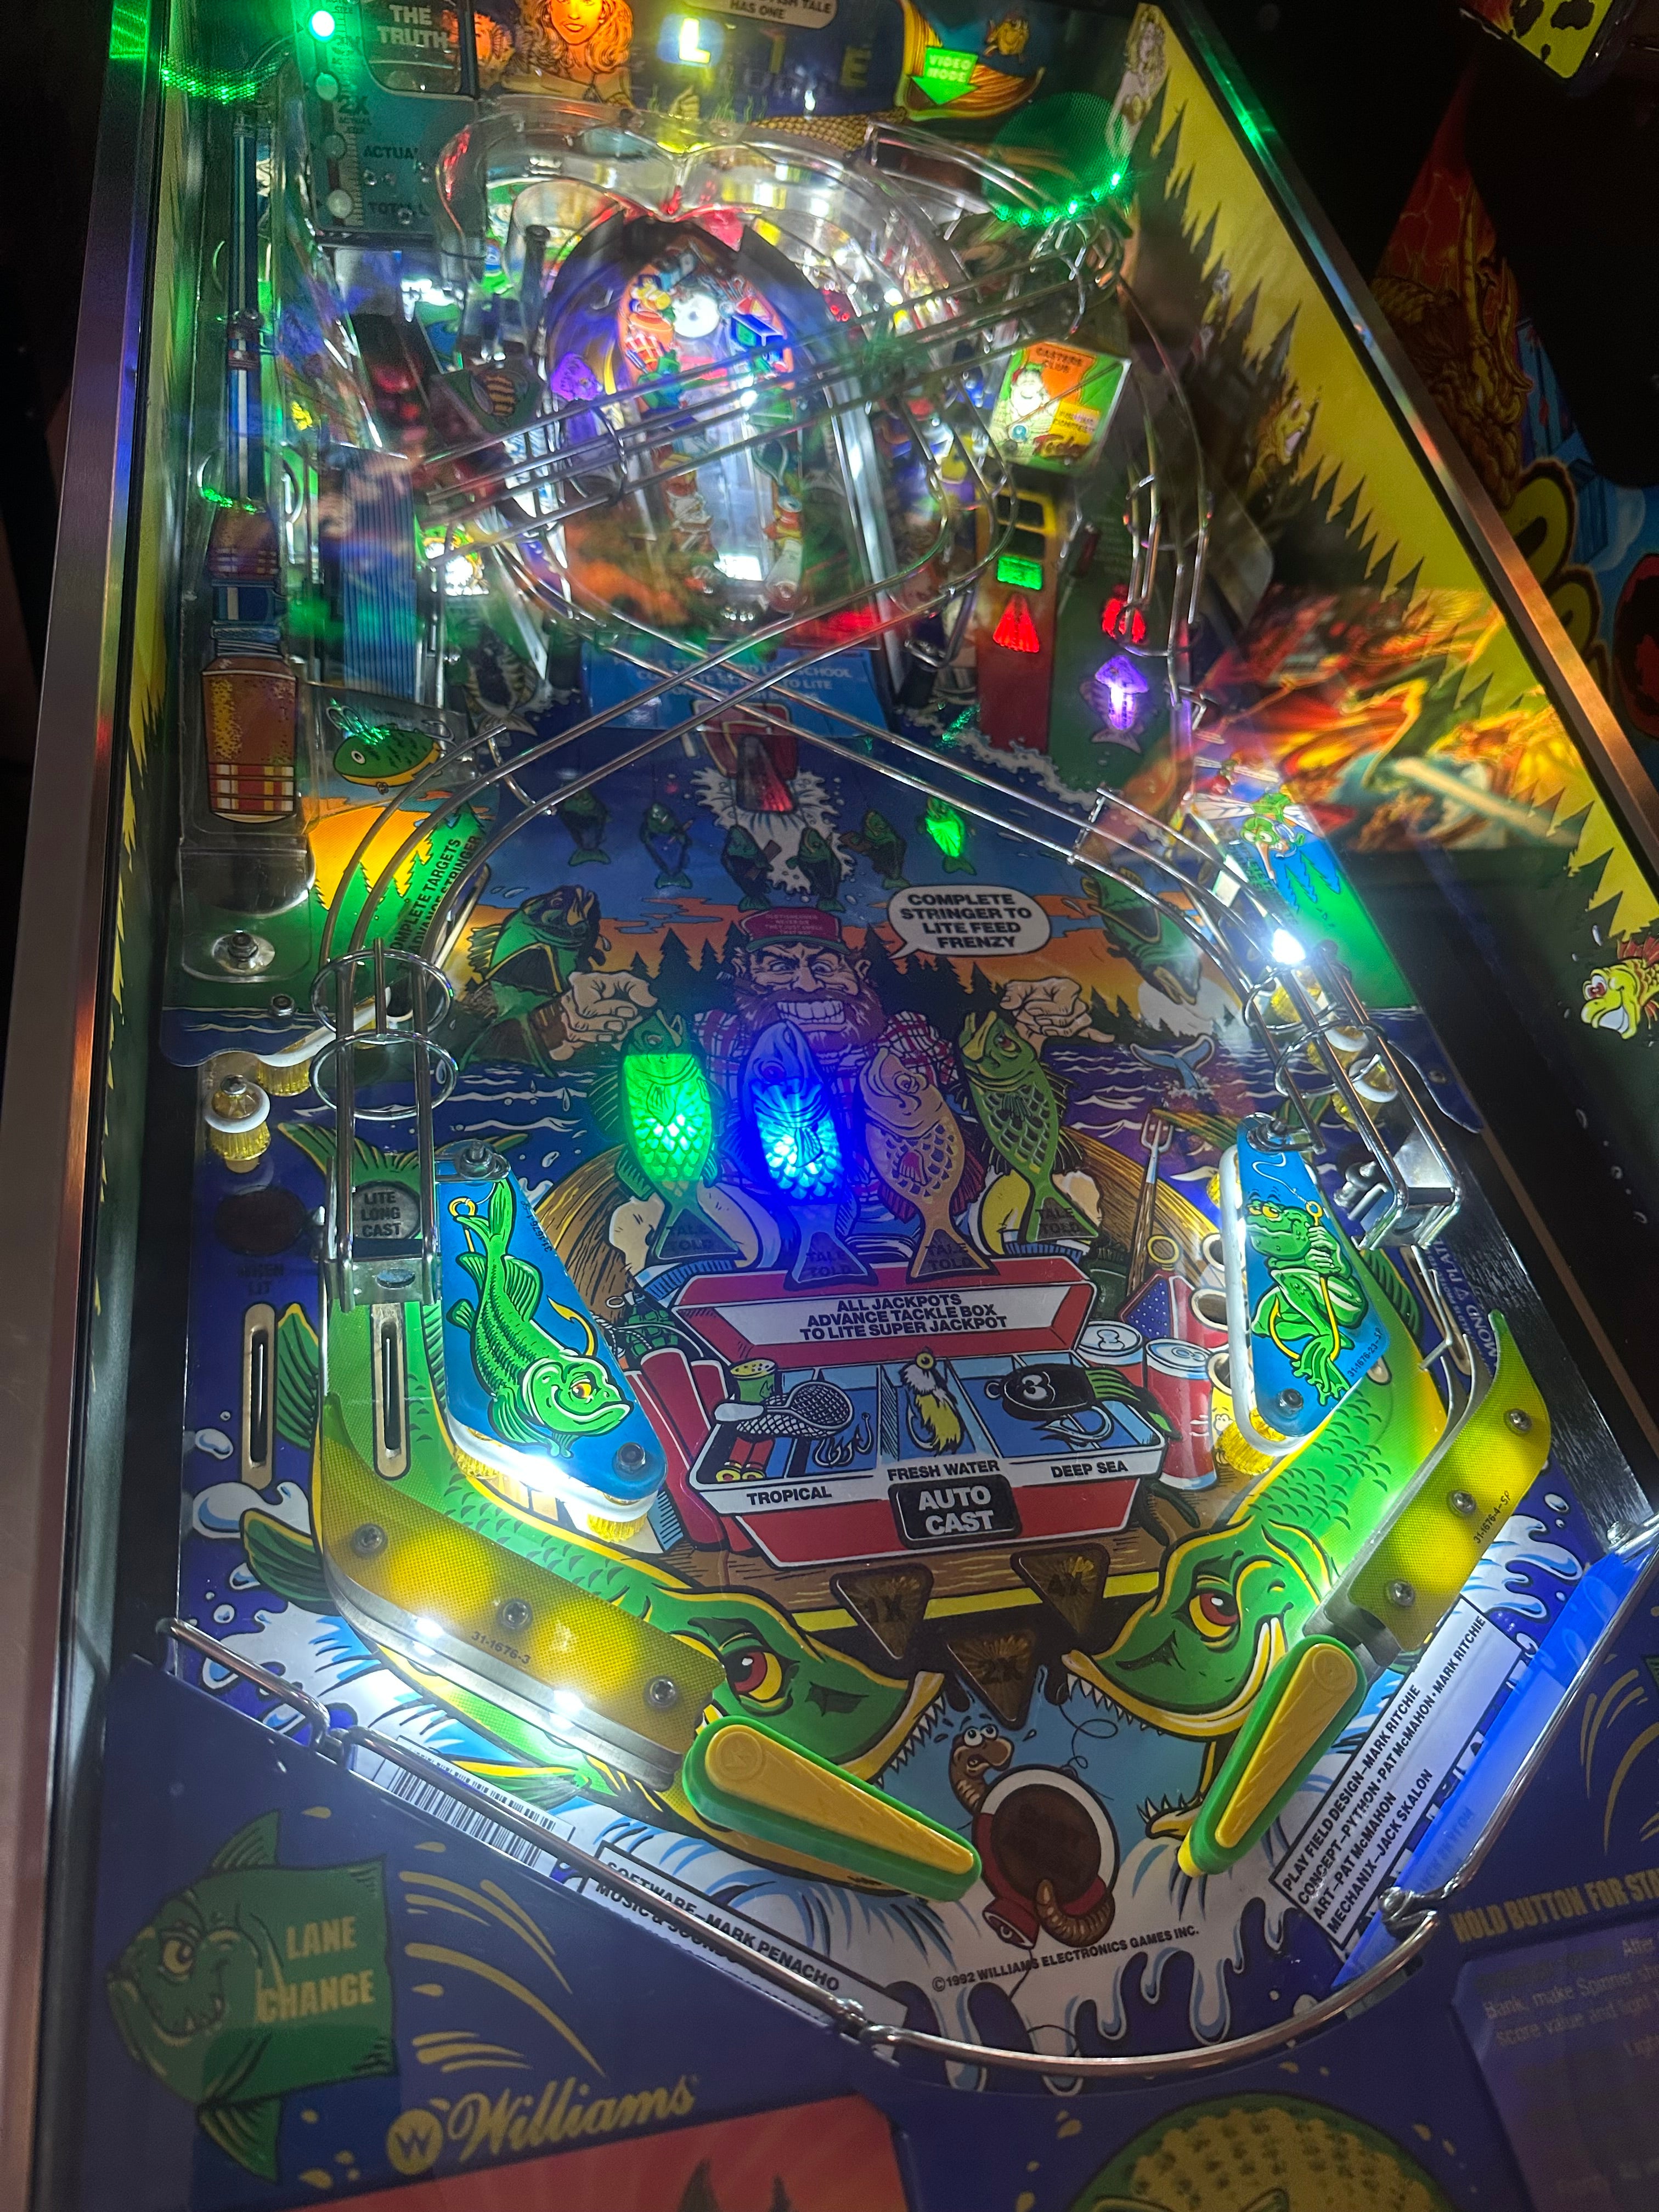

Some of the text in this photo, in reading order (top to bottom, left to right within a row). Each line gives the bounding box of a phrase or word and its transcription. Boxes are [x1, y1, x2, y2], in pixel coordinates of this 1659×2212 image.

[388, 4, 433, 25] THE
[730, 1, 756, 14] HAS
[759, 5, 785, 20] ONE
[377, 25, 449, 48] TRUTH
[680, 18, 711, 64] L
[929, 55, 973, 70] VIDEO
[927, 67, 967, 83] MODE
[803, 680, 833, 690] LITE
[390, 893, 430, 950] OMPLETE
[422, 838, 462, 893] TARGETS
[908, 894, 1015, 906] COMPLETE
[901, 908, 1032, 920] STRINGER TO
[922, 922, 1022, 935] LITE FEED
[937, 936, 1016, 949] FRENZY
[364, 1191, 396, 1205] LITE
[360, 1206, 401, 1222] LONG
[362, 1223, 402, 1238] CAST
[837, 1293, 962, 1313] ALL JACKPOTS
[807, 1304, 998, 1328] ADVANCE TACKLE BOX
[799, 1316, 1008, 1341] TO LITE SUPER JACKPOT
[1465, 1304, 1497, 1358] MOND
[887, 1459, 1001, 1481] FRESH WATER
[1049, 1459, 1128, 1479] DEEP SEA
[746, 1485, 833, 1506] TROPICAL
[917, 1485, 992, 1512] AUTO
[924, 1510, 994, 1536] CAST
[471, 1631, 531, 1664] 31-1676-3
[1377, 1752, 1398, 1780] PAT
[1391, 1694, 1436, 1757] McMAHON
[1432, 1658, 1459, 1694] MARK
[1453, 1615, 1486, 1661] RITCHIE
[1283, 1854, 1310, 1891] PLAY
[1305, 1816, 1334, 1858] FIELD
[1385, 1684, 1420, 1734] RITCHIE
[1396, 1768, 1434, 1822] SKALON
[1349, 1791, 1397, 1860] McMAHON
[1452, 1905, 1506, 1943] HOLD
[1504, 1886, 1588, 1929] BUTTON
[1584, 1877, 1629, 1911] FOR
[286, 1916, 357, 1960] LANE
[756, 1939, 840, 1991] PENACHO
[977, 1959, 1040, 1982] WILLIAMS
[1041, 1939, 1128, 1968] ELECTRONICS
[1130, 1930, 1173, 1949] GAMES
[1174, 1925, 1200, 1940] INC.
[256, 1970, 375, 2023] CHANGE
[447, 2075, 696, 2162] Williams
